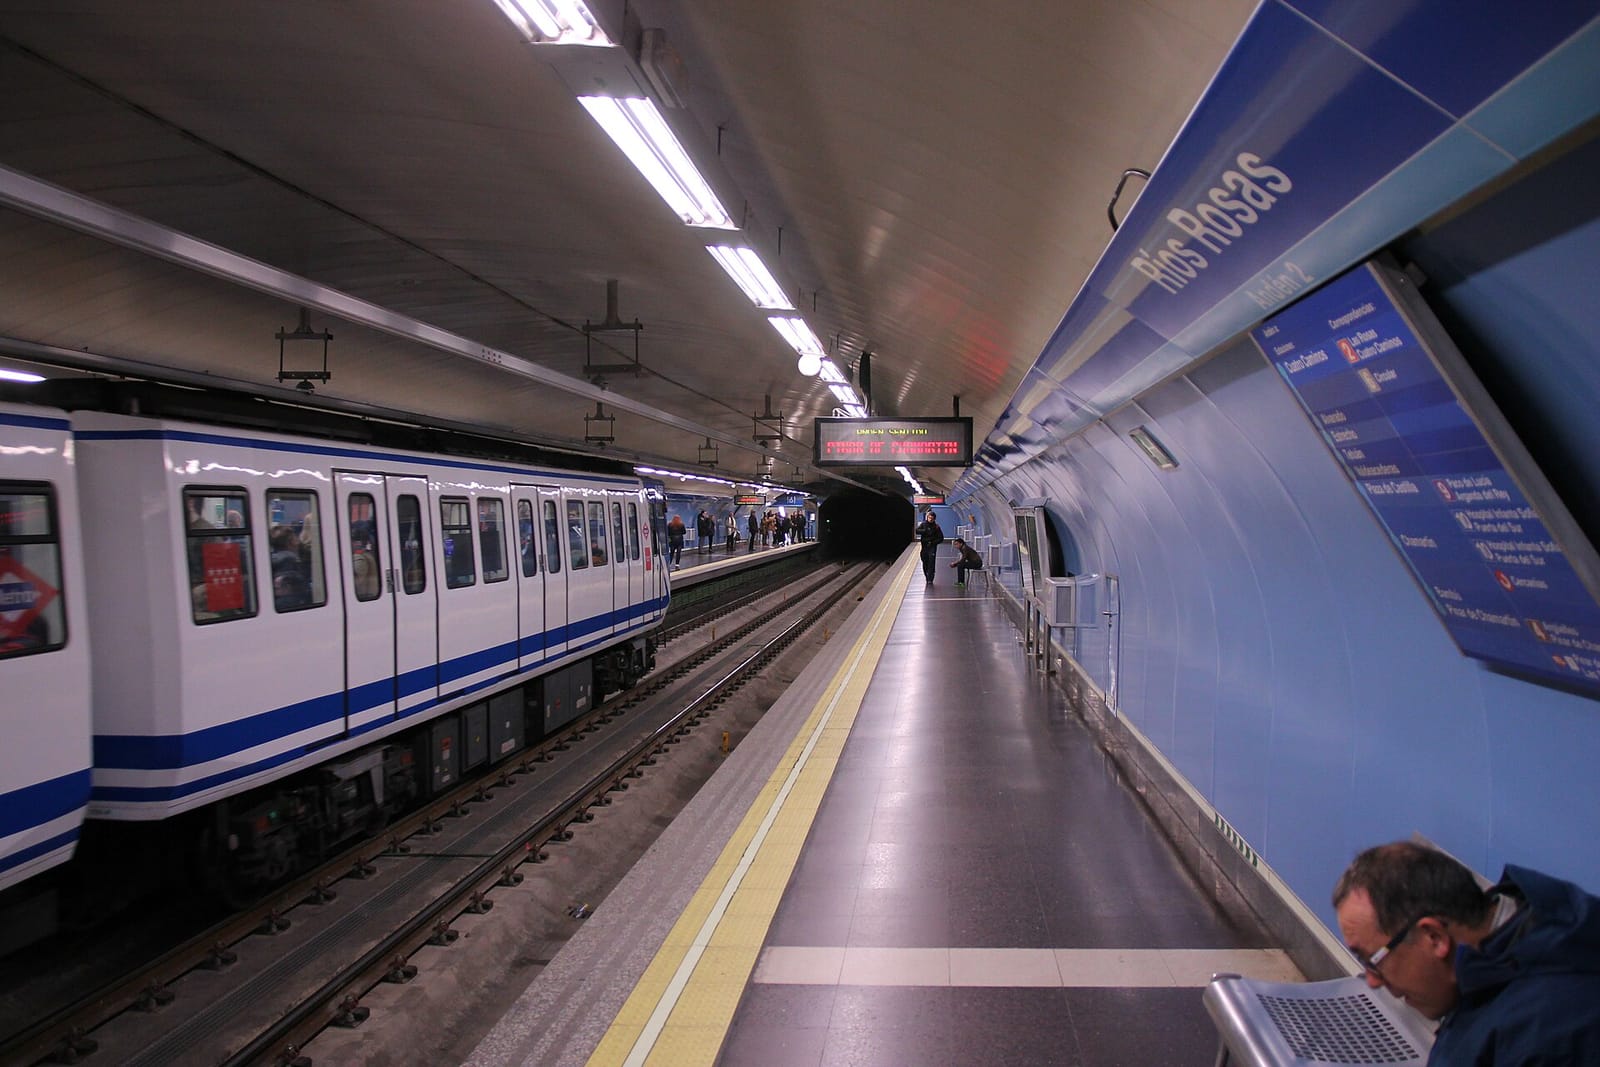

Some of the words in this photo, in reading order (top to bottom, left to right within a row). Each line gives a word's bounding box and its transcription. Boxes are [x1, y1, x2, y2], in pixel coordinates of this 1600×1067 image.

[1166, 152, 1293, 254] Rosas
[1130, 238, 1208, 295] Ríos
[1284, 261, 1314, 284] 2
[1356, 328, 1378, 342] Rosas
[1374, 336, 1403, 353] Caminos
[1300, 349, 1329, 367] Caminos
